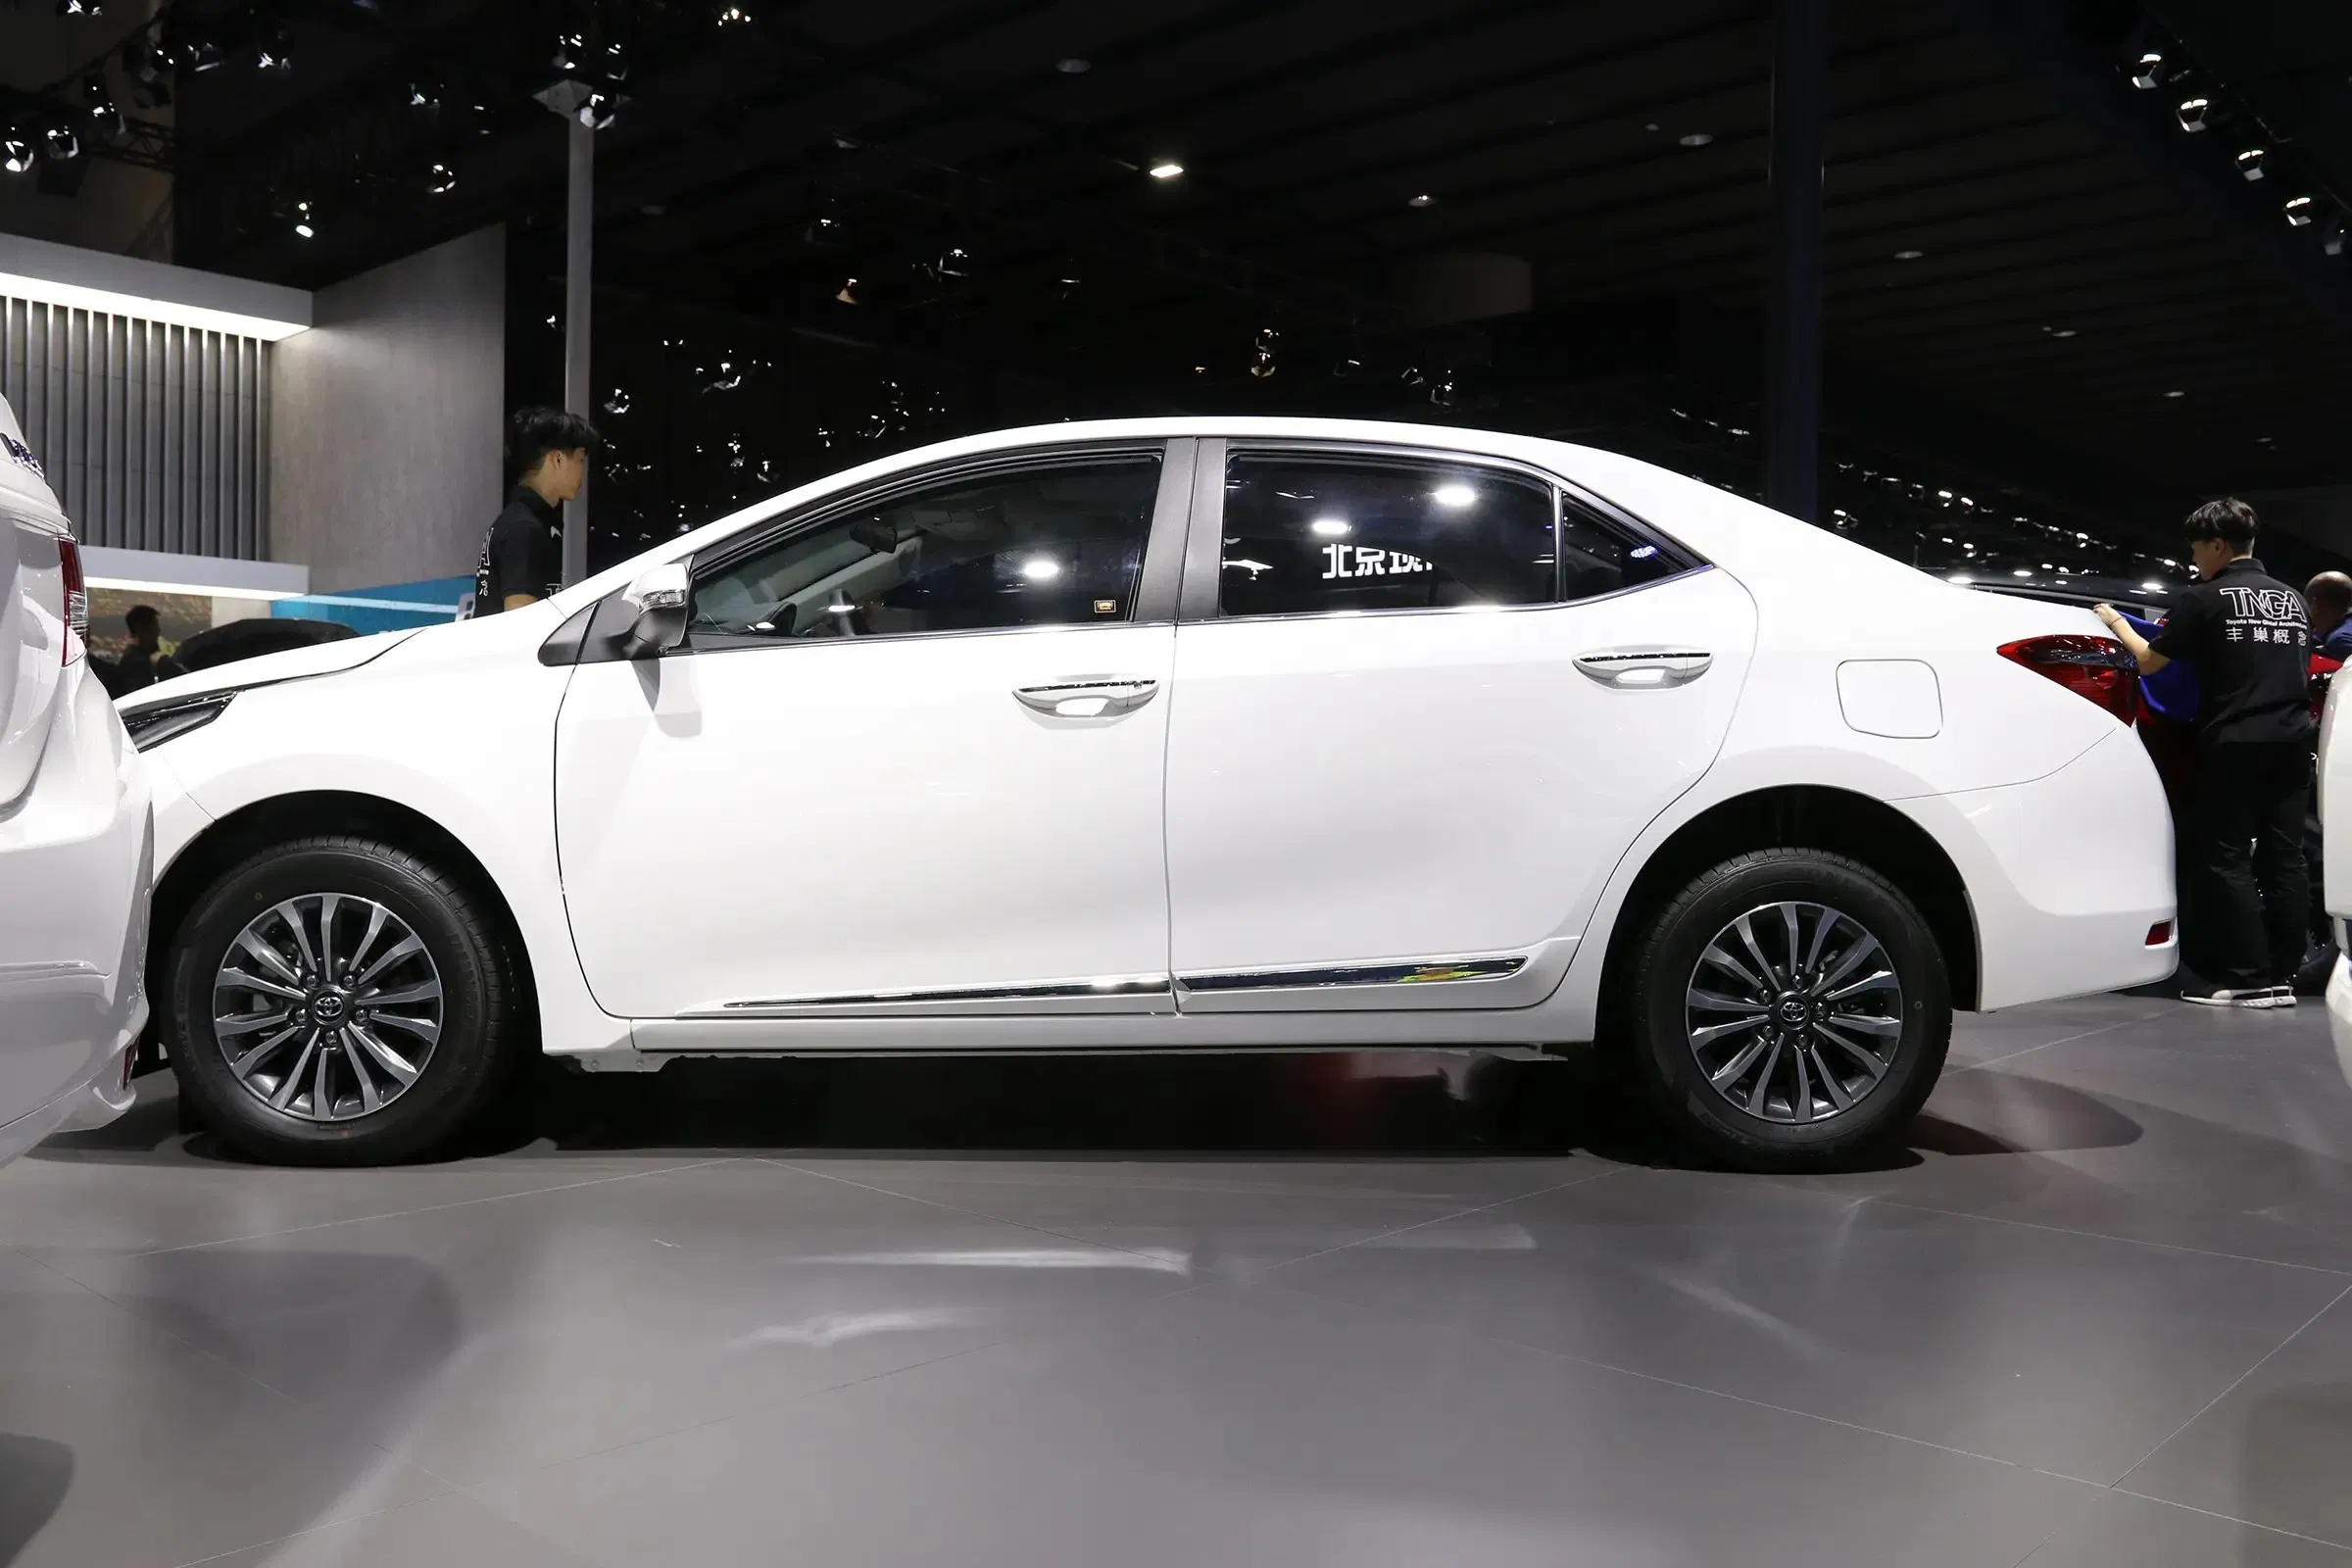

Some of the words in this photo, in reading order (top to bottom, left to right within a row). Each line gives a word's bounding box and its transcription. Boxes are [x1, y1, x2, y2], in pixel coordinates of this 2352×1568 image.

[1322, 543, 1433, 579] 北京现
[2220, 587, 2307, 622] TNGA
